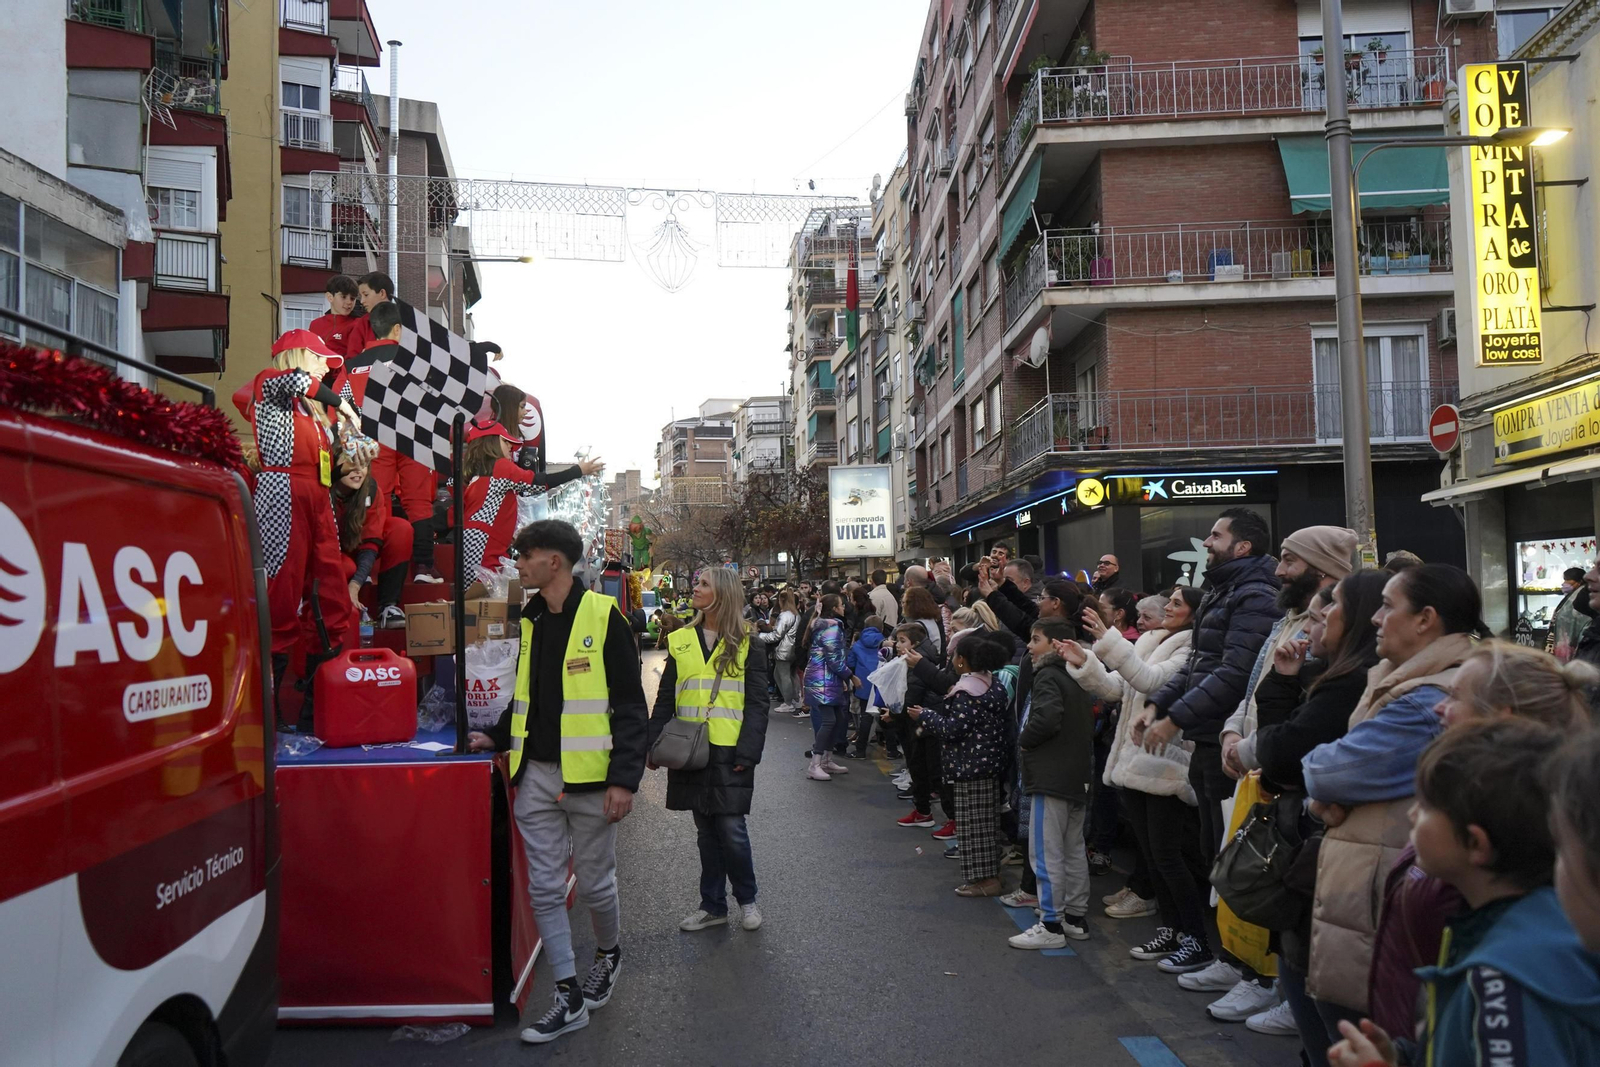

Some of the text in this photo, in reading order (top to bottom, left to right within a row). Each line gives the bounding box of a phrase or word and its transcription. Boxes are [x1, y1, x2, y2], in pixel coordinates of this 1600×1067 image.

[1510, 237, 1531, 257] de
[1483, 271, 1532, 300] ORO y
[1483, 306, 1537, 330] PLATA
[1485, 333, 1539, 349] Joyería
[1486, 347, 1540, 360] low cost
[1495, 403, 1545, 437] COMPRA
[1546, 389, 1590, 423] VENTA
[1589, 417, 1600, 437] lo
[1171, 478, 1247, 495] CaixaBank
[54, 541, 209, 668] ASC
[1515, 633, 1535, 647] 20%
[363, 666, 401, 682] ASC
[128, 681, 208, 714] CARBURANTES
[465, 692, 498, 701] ORLD
[156, 846, 244, 910] Servicio Técnico
